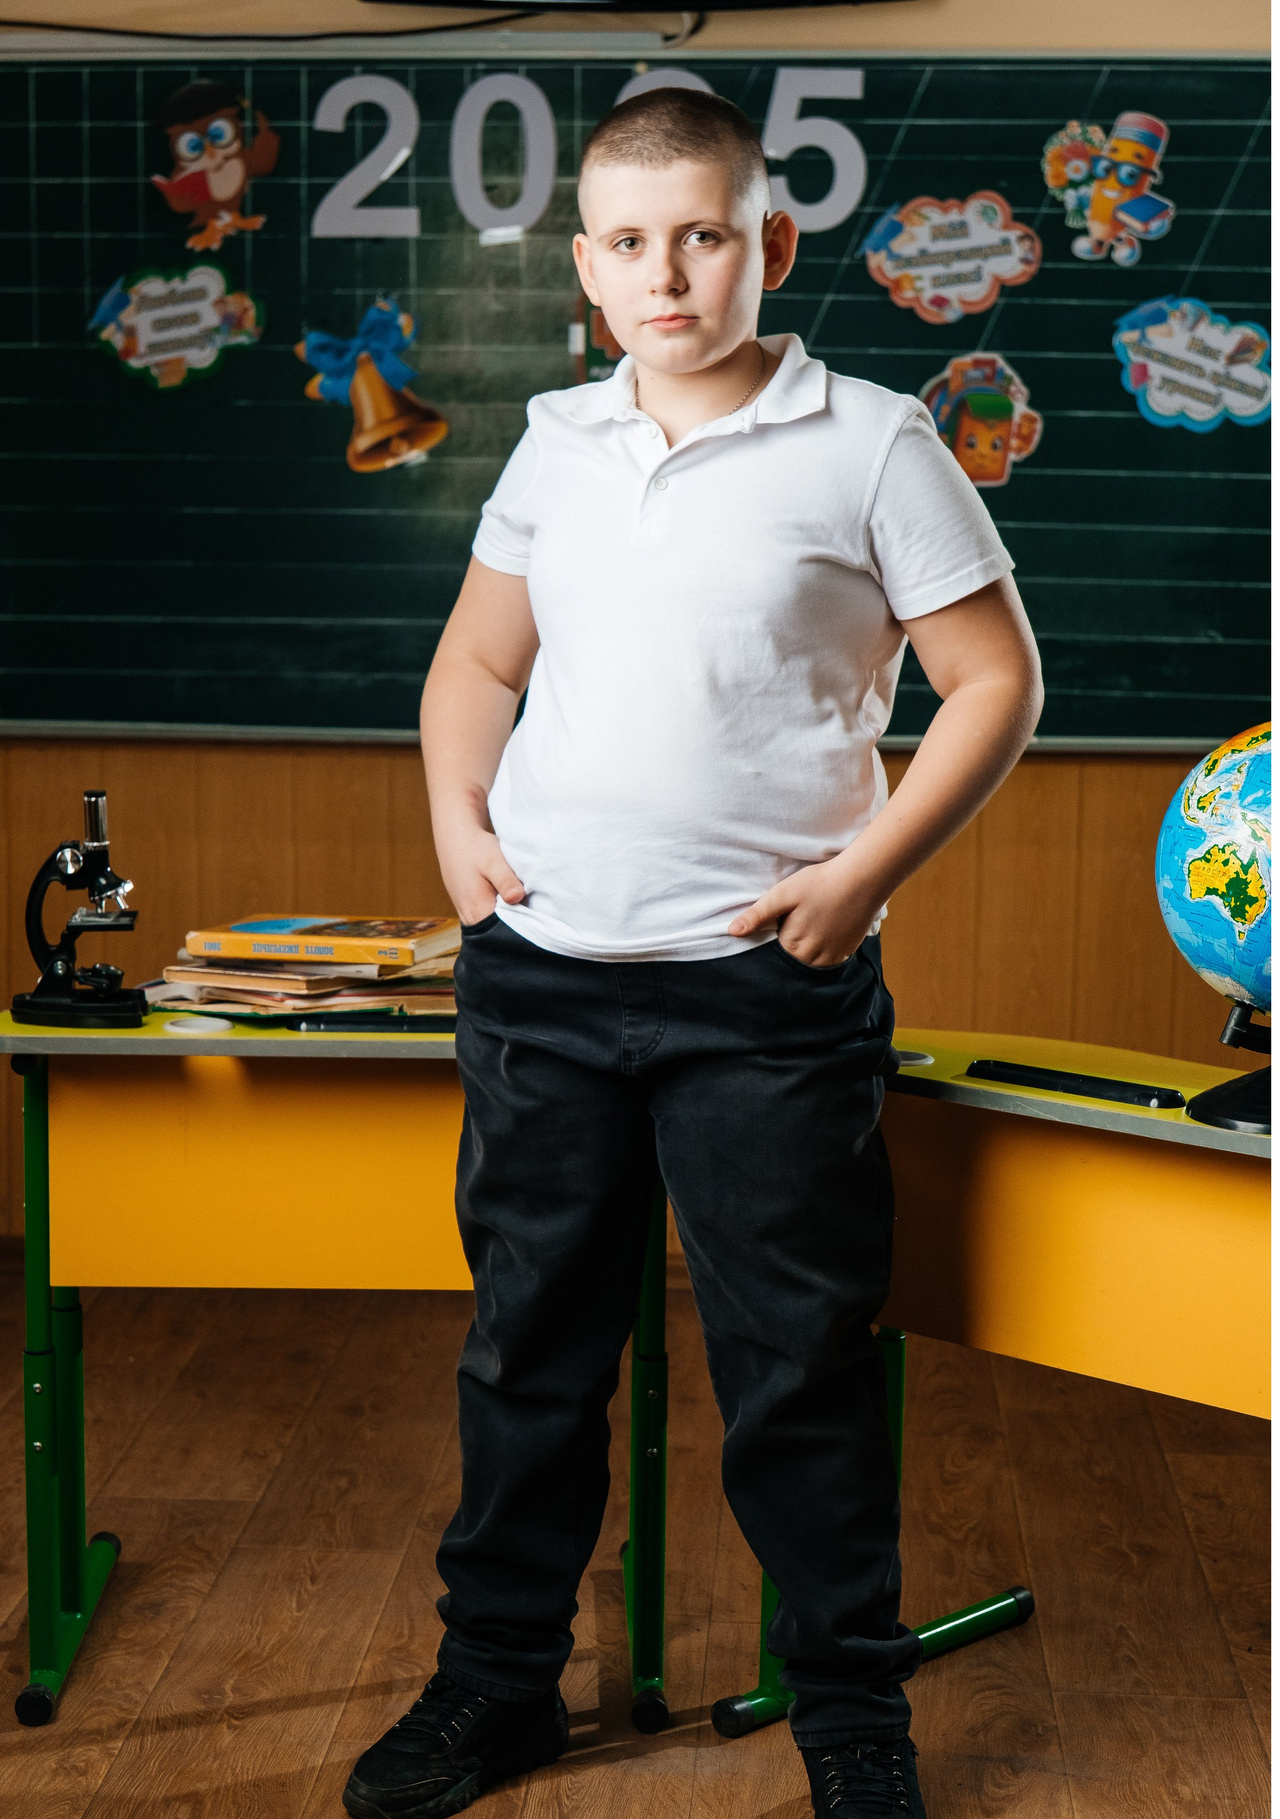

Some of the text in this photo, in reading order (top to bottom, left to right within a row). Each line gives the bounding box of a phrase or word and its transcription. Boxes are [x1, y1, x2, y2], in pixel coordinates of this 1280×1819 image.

[311, 67, 867, 238] 205
[252, 943, 300, 955] ДЖЕРЕЛЬЦЕ
[305, 945, 334, 956] ЗОЛОТЕ
